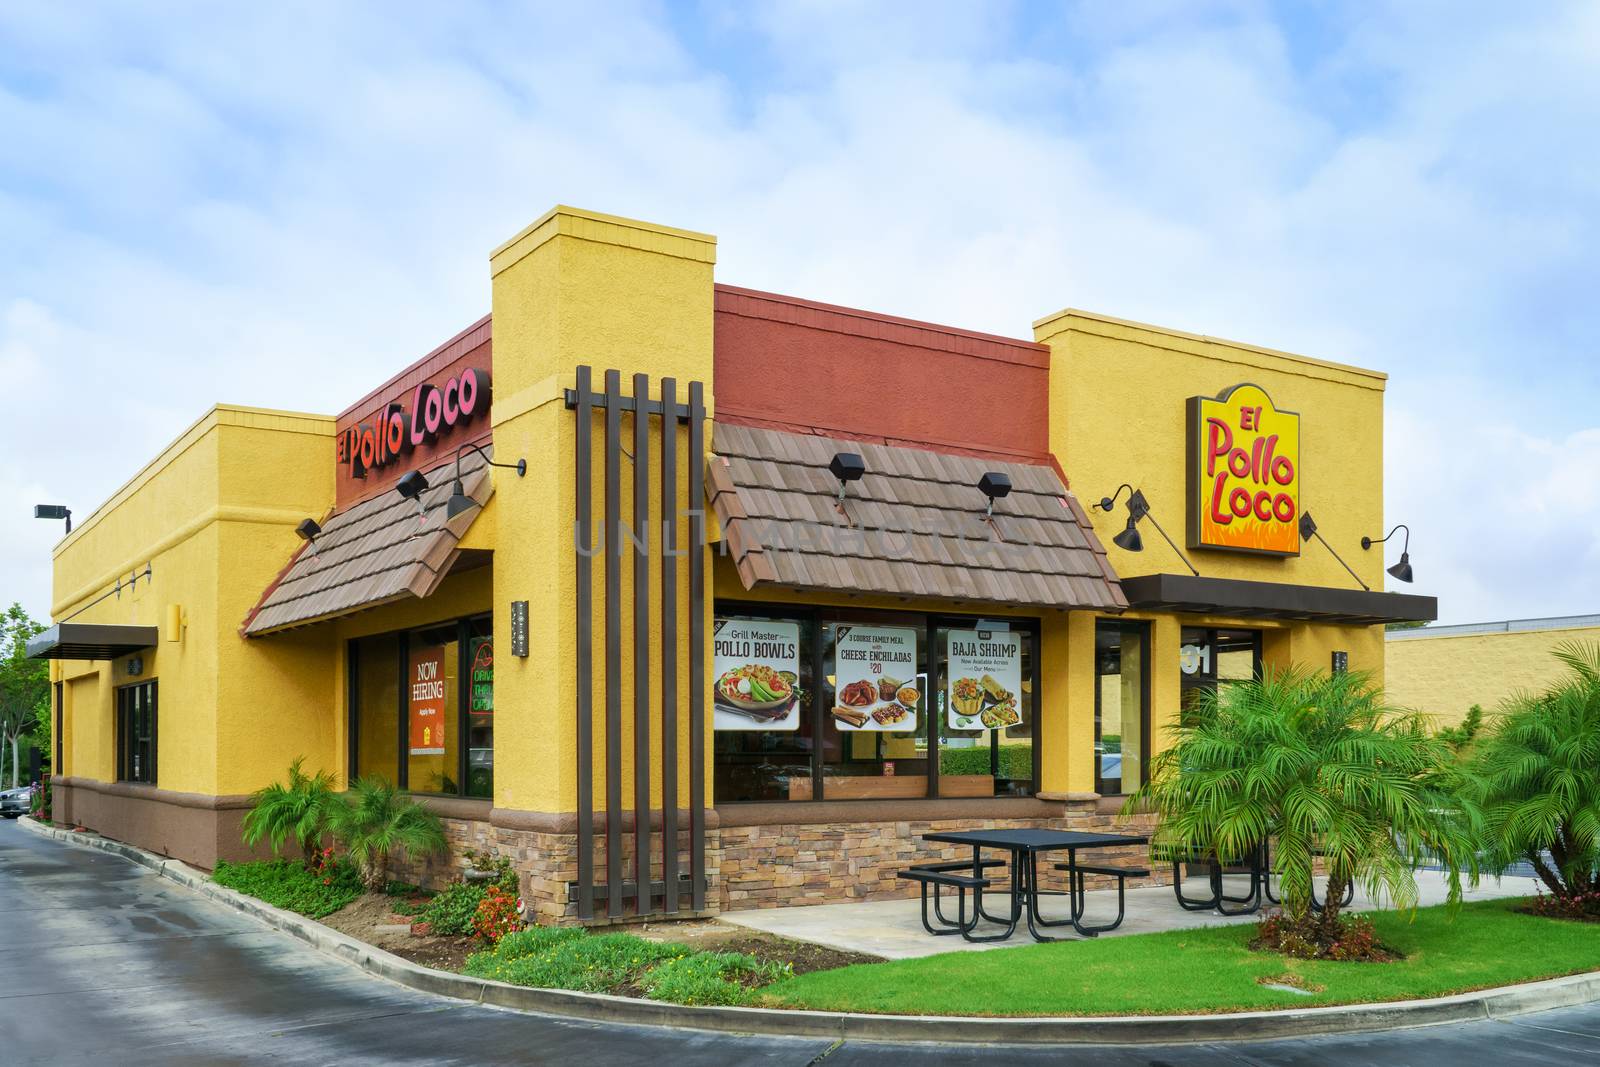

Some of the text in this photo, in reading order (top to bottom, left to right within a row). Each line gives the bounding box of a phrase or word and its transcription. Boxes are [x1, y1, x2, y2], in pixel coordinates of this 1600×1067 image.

[336, 367, 478, 479] El Pollo Loco
[1239, 406, 1262, 432] El
[1206, 417, 1295, 486] Pollo
[1211, 470, 1295, 525] Loco
[731, 630, 778, 641] Grill Master
[853, 635, 872, 643] COURSE
[872, 636, 889, 644] FAMILY
[890, 637, 904, 645] MEAL
[714, 640, 795, 659] POLLO BOWLS
[841, 649, 912, 663] CHEESE ENCHILADAS
[952, 641, 1017, 658] BAJA SHRIMP
[417, 661, 438, 681] NOW
[870, 662, 882, 674] $20
[412, 681, 443, 701] HIRING
